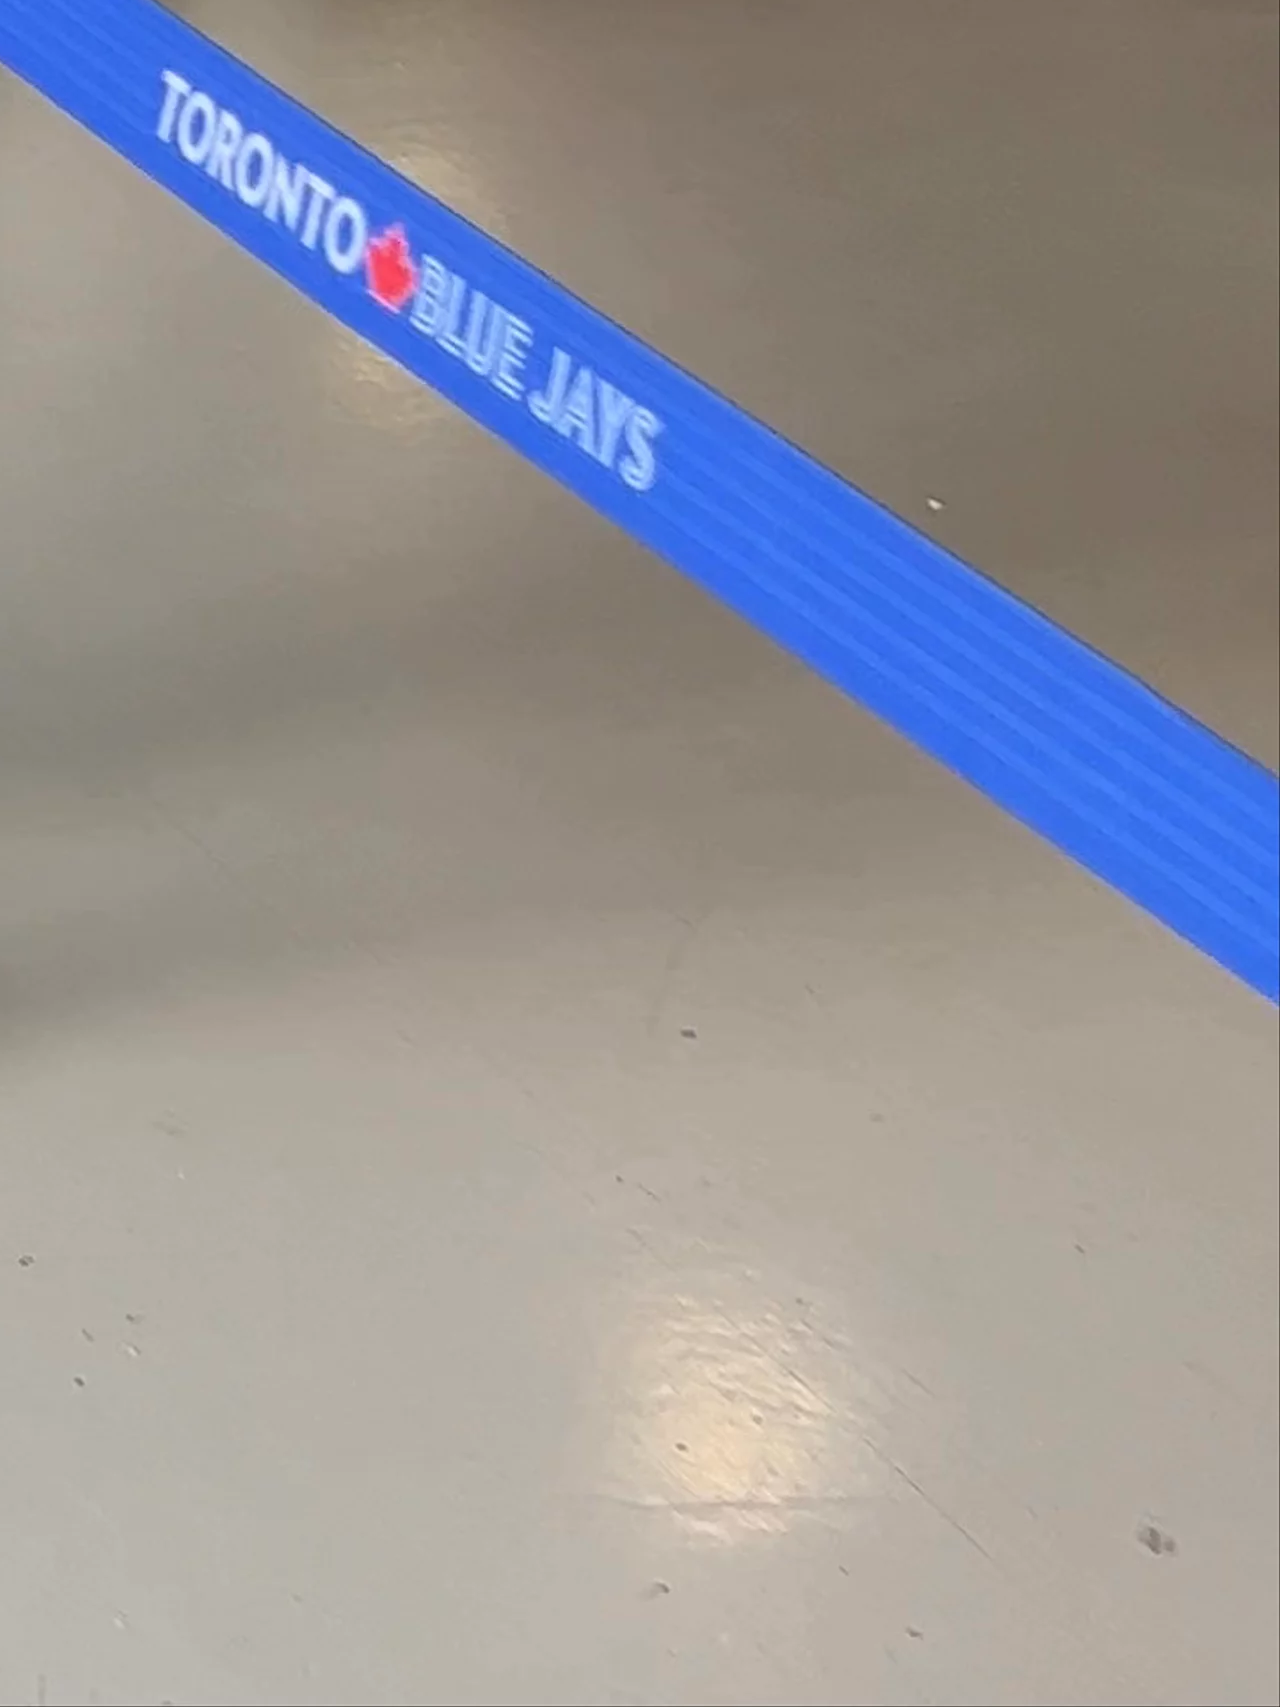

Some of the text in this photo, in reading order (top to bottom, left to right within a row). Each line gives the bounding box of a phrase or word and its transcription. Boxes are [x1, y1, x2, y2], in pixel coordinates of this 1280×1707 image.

[155, 69, 668, 493] TORONTO BLUE JAYS
